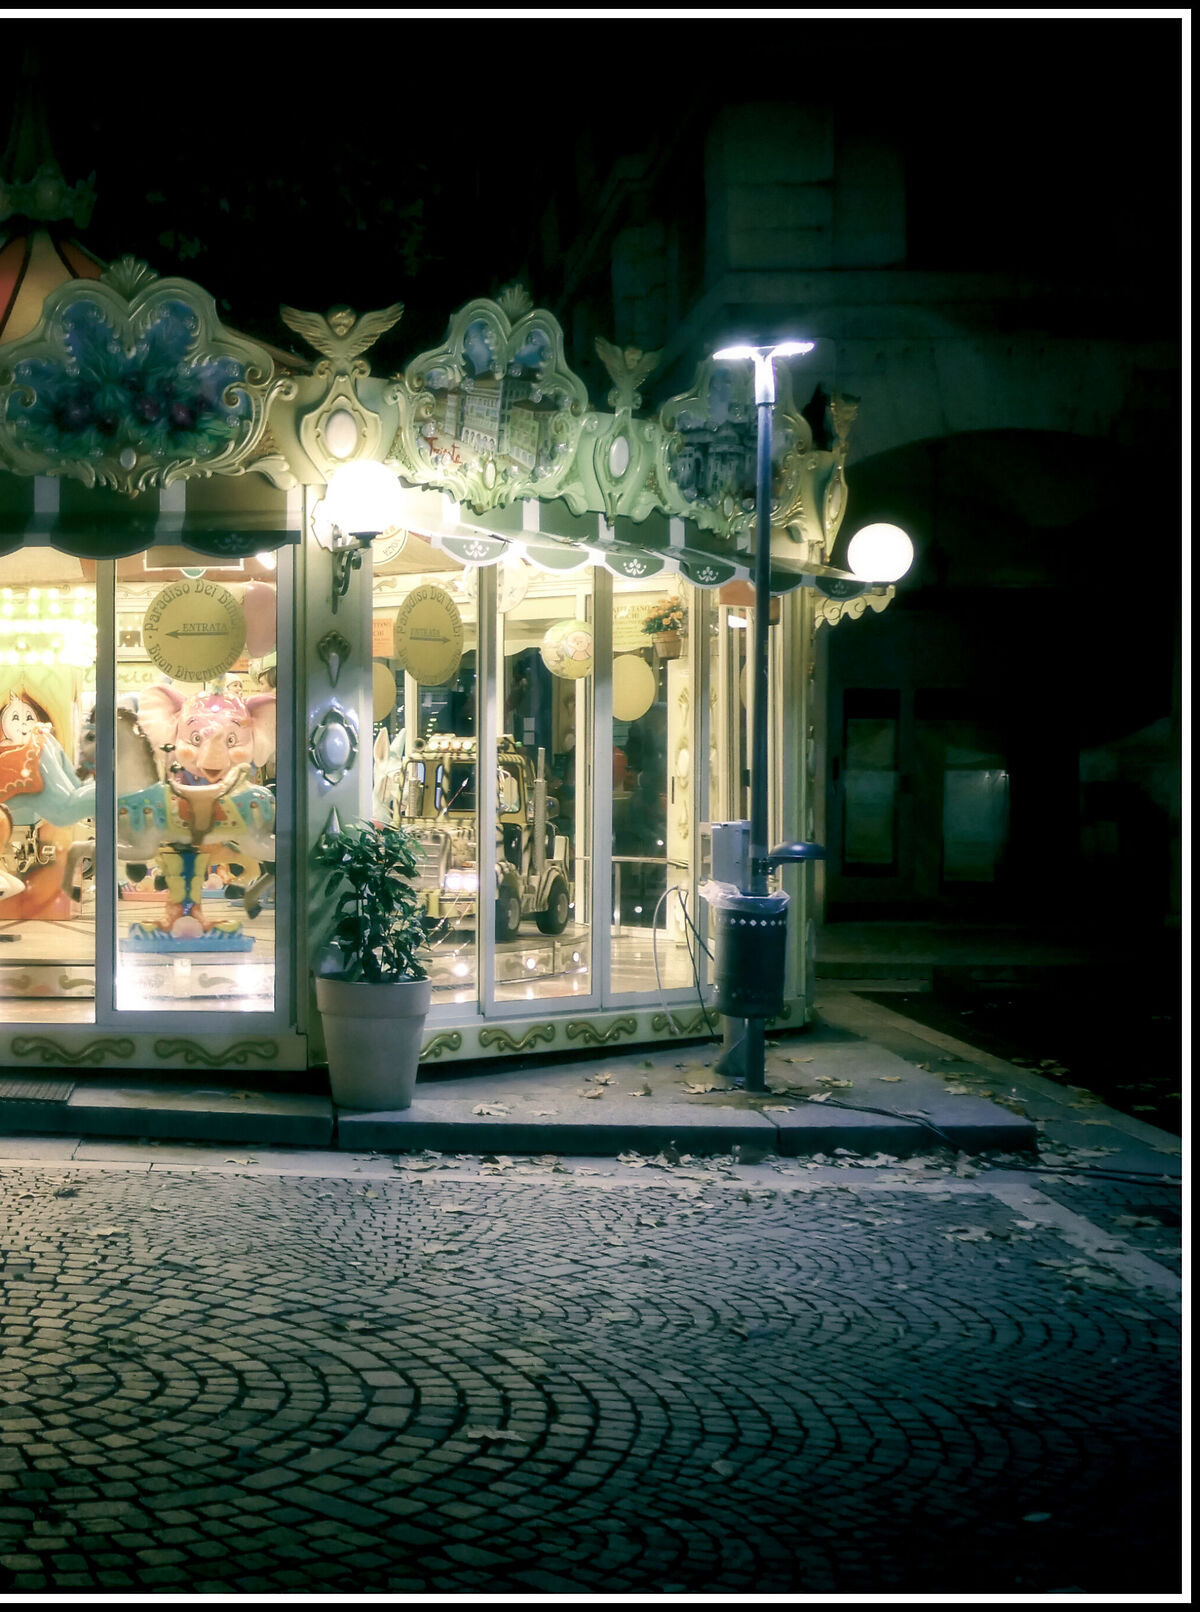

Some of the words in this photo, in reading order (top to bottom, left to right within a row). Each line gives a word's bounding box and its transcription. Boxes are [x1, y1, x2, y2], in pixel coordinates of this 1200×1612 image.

[144, 583, 190, 632] Paradiso
[194, 579, 218, 598] Dei
[397, 589, 428, 634] Paradiso
[430, 586, 446, 604] Dei
[183, 623, 228, 632] ENTRATA
[149, 643, 173, 673] Buon
[175, 645, 243, 681] Divertiment
